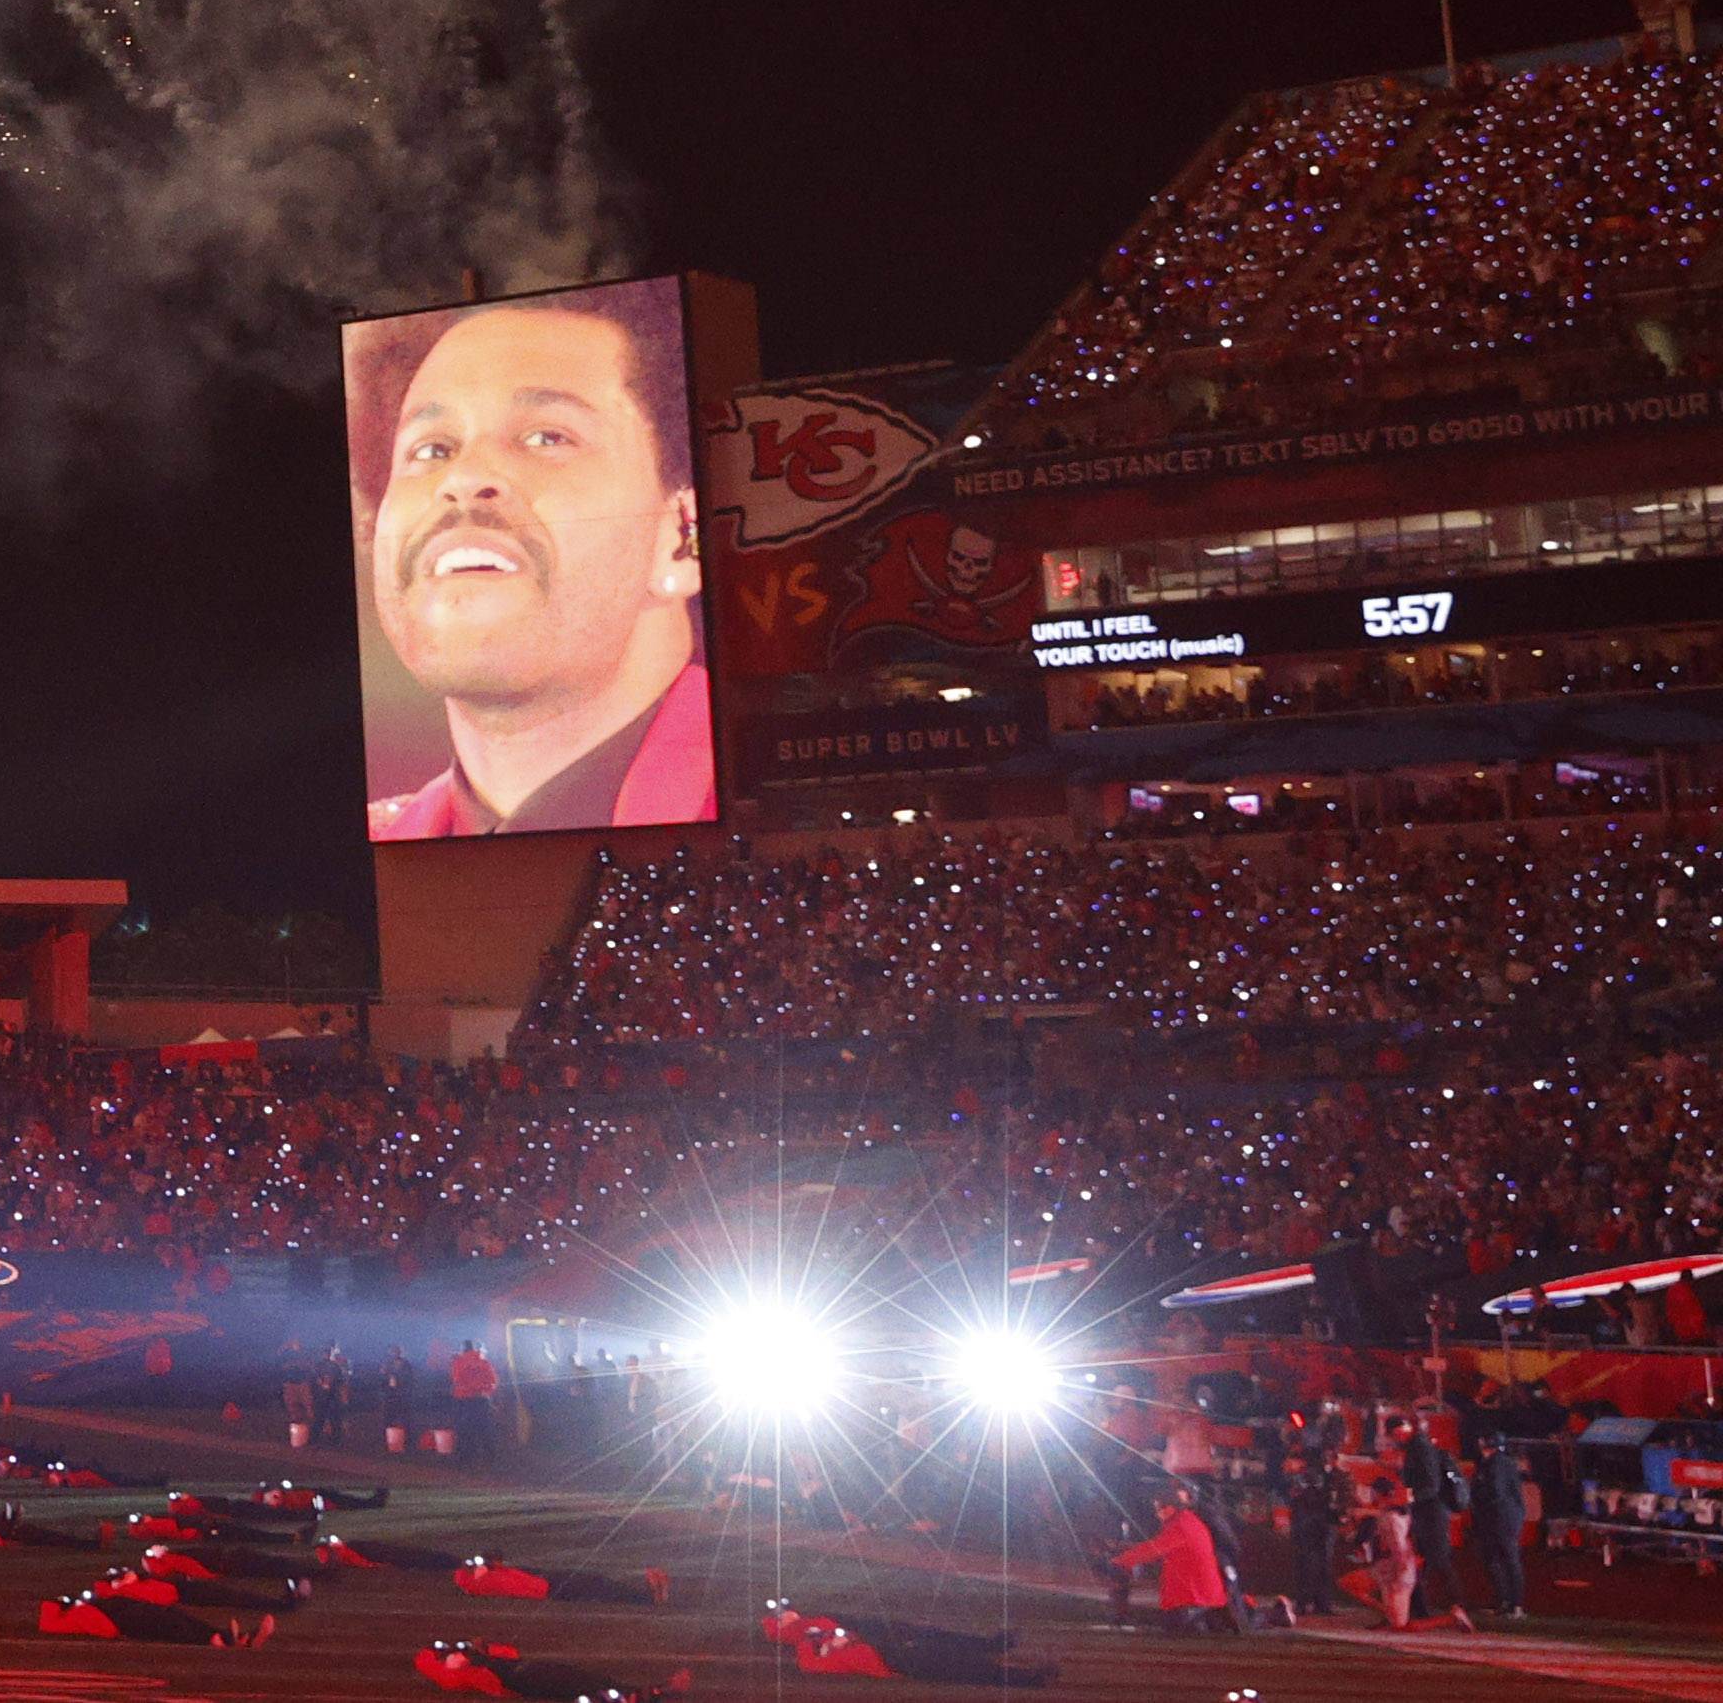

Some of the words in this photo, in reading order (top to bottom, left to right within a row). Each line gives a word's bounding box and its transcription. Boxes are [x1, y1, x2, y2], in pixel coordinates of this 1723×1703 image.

[955, 468, 1025, 498] NEED
[1032, 447, 1214, 488] ASSISTANCE?
[1222, 438, 1293, 468] TEXT
[1301, 430, 1376, 461] SBLV
[1381, 424, 1419, 451] TO
[1427, 413, 1526, 446] 69050
[1532, 401, 1616, 435] WITH
[1623, 390, 1710, 424] YOUR
[738, 560, 829, 635] VS
[1361, 591, 1455, 638] 5:57
[1031, 618, 1092, 643] UNTIL
[1093, 618, 1103, 638] I
[1104, 614, 1159, 637] FEEL
[1033, 644, 1094, 668] YOUR
[1096, 639, 1168, 665] TOUCH
[1169, 633, 1245, 662] (music)
[778, 733, 872, 762] SUPER
[886, 727, 971, 754] BOWL
[986, 722, 1019, 747] LV
